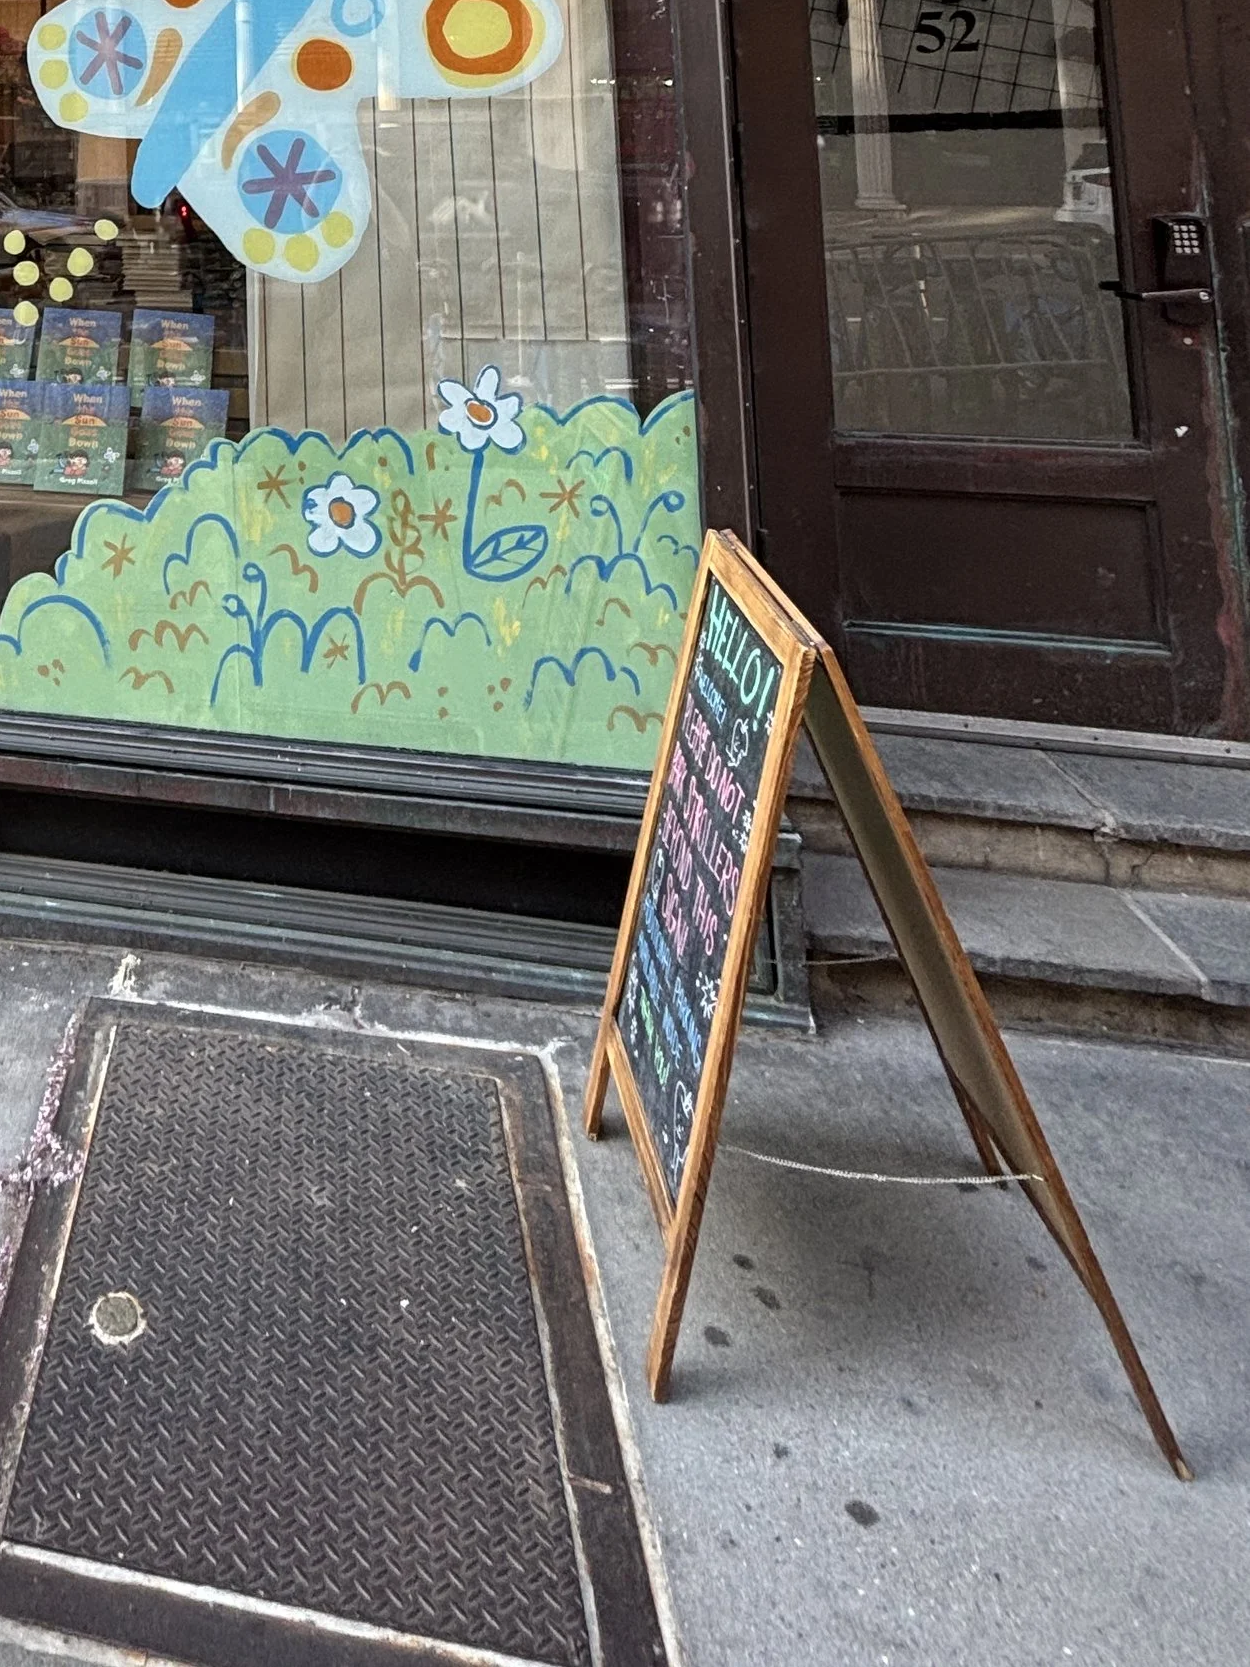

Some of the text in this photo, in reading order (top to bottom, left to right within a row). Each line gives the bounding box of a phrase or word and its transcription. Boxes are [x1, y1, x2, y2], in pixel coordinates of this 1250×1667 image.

[915, 9, 980, 54] 52
[69, 317, 97, 327] When
[161, 319, 189, 330] When
[70, 337, 89, 346] Sun
[0, 388, 28, 398] When
[73, 393, 103, 404] When
[171, 395, 202, 407] When
[0, 409, 20, 418] Sun
[74, 414, 96, 425] Sun
[172, 417, 193, 427] Sun
[68, 437, 99, 449] Down
[165, 437, 196, 449] Down
[705, 584, 776, 733] HELLO!
[681, 692, 746, 825] PLEASE DO NOT
[683, 775, 740, 917] STROLLERS
[661, 799, 718, 957] BEYOND THIS
[672, 976, 702, 1070] PARKING
